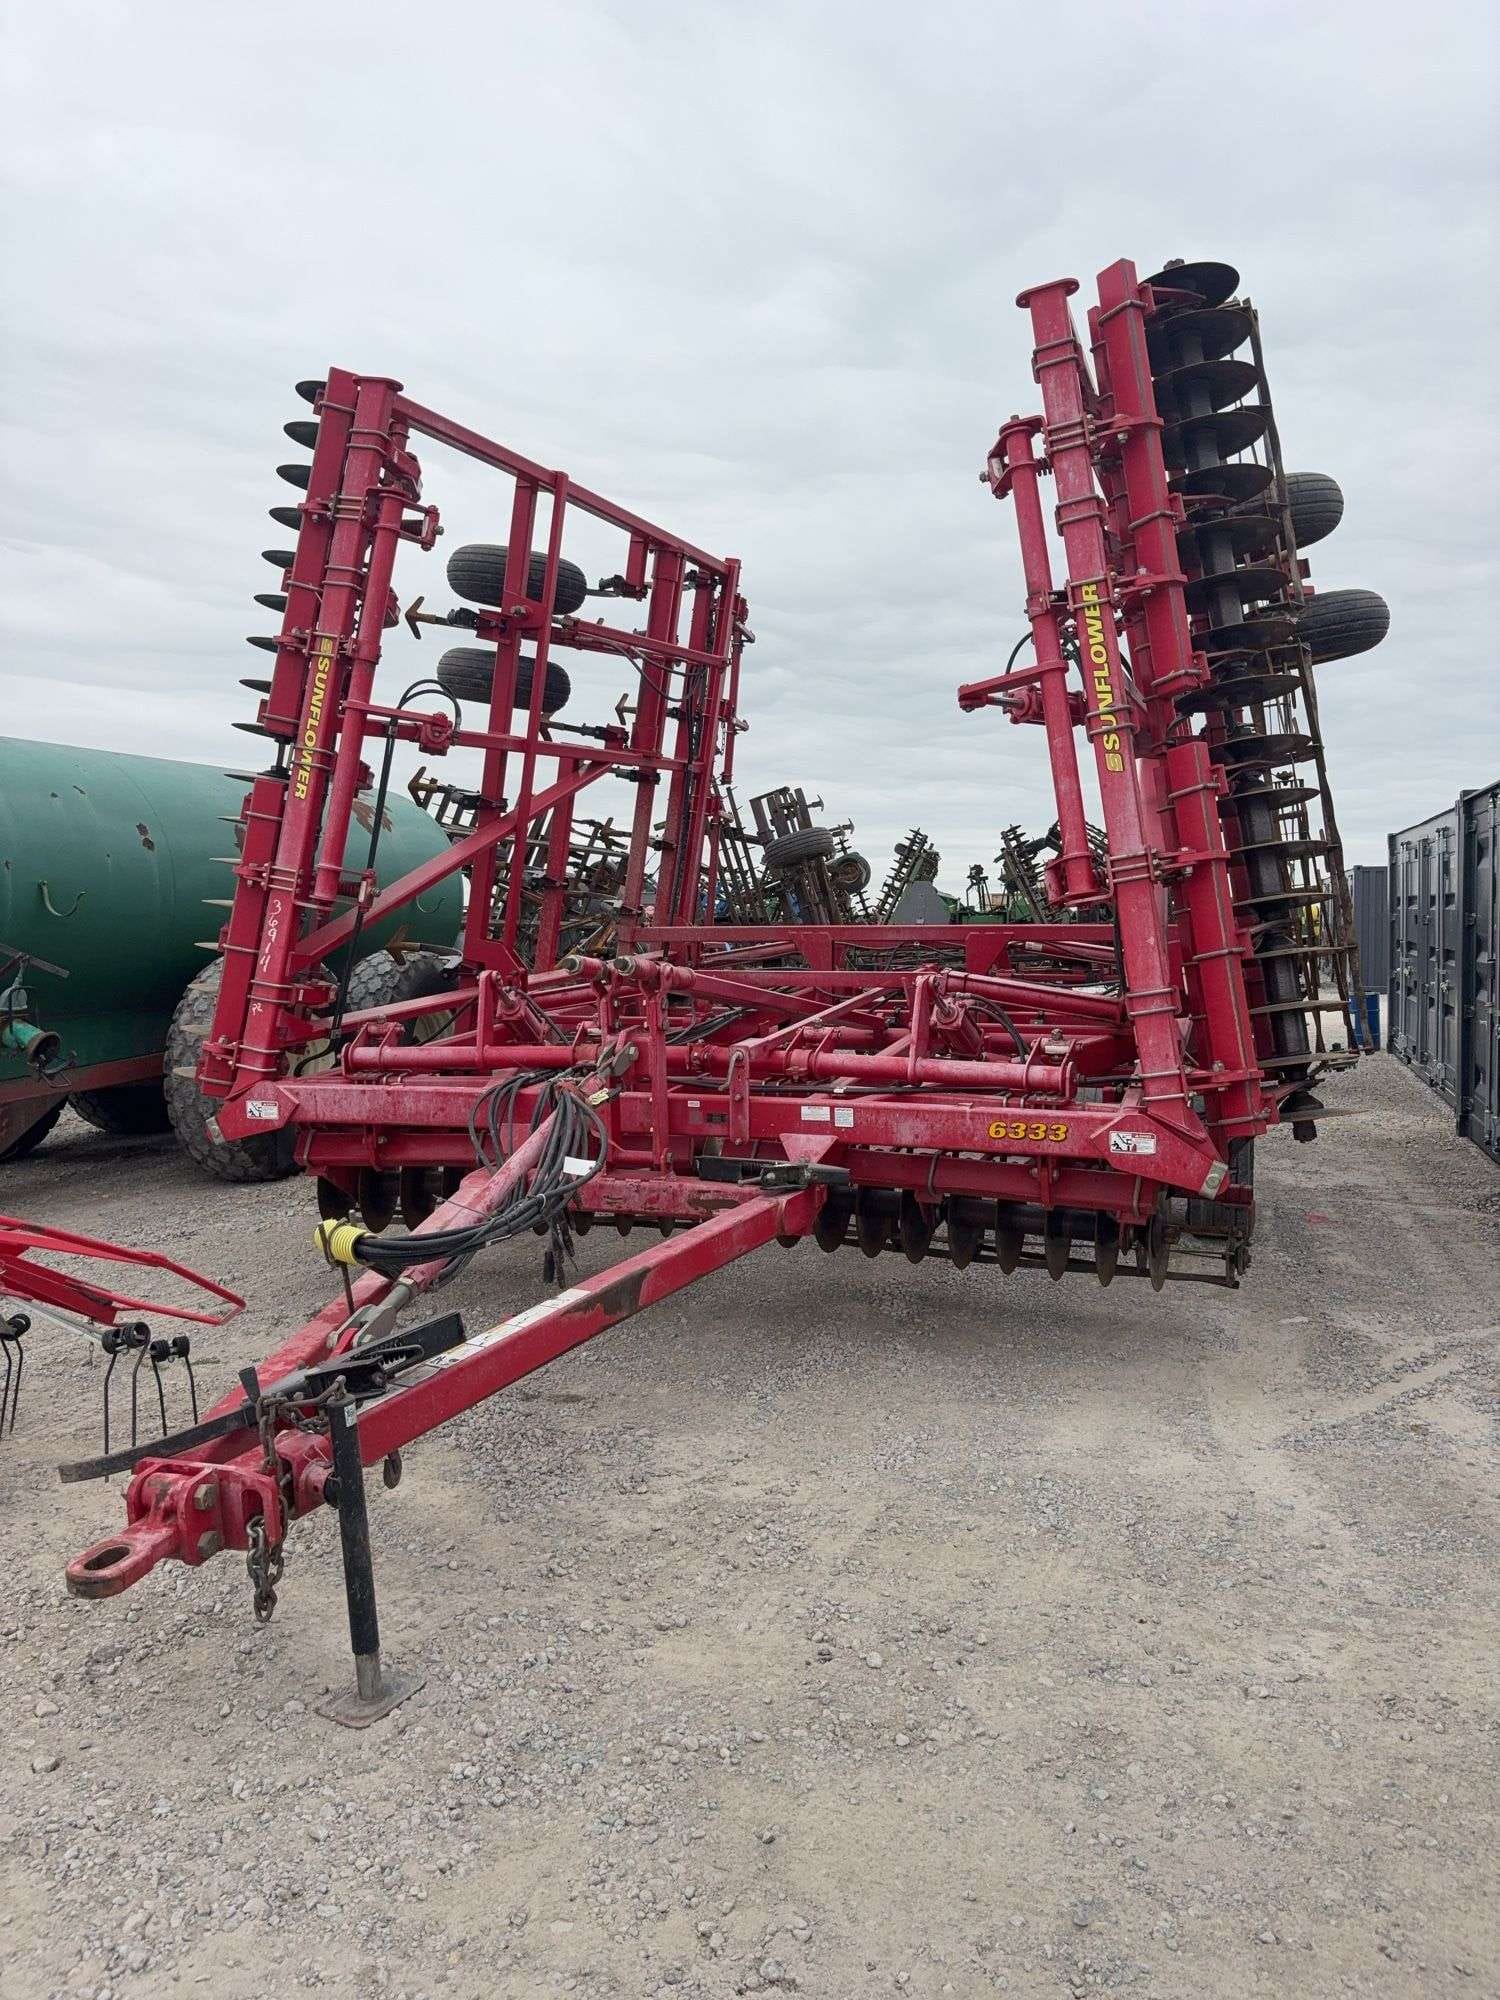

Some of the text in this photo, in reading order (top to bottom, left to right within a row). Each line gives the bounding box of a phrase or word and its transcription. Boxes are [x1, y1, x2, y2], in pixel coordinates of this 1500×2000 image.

[294, 656, 330, 800] SUNFLOWER
[1082, 583, 1120, 751] SUNFLOWER
[988, 1121, 1068, 1141] 6333
